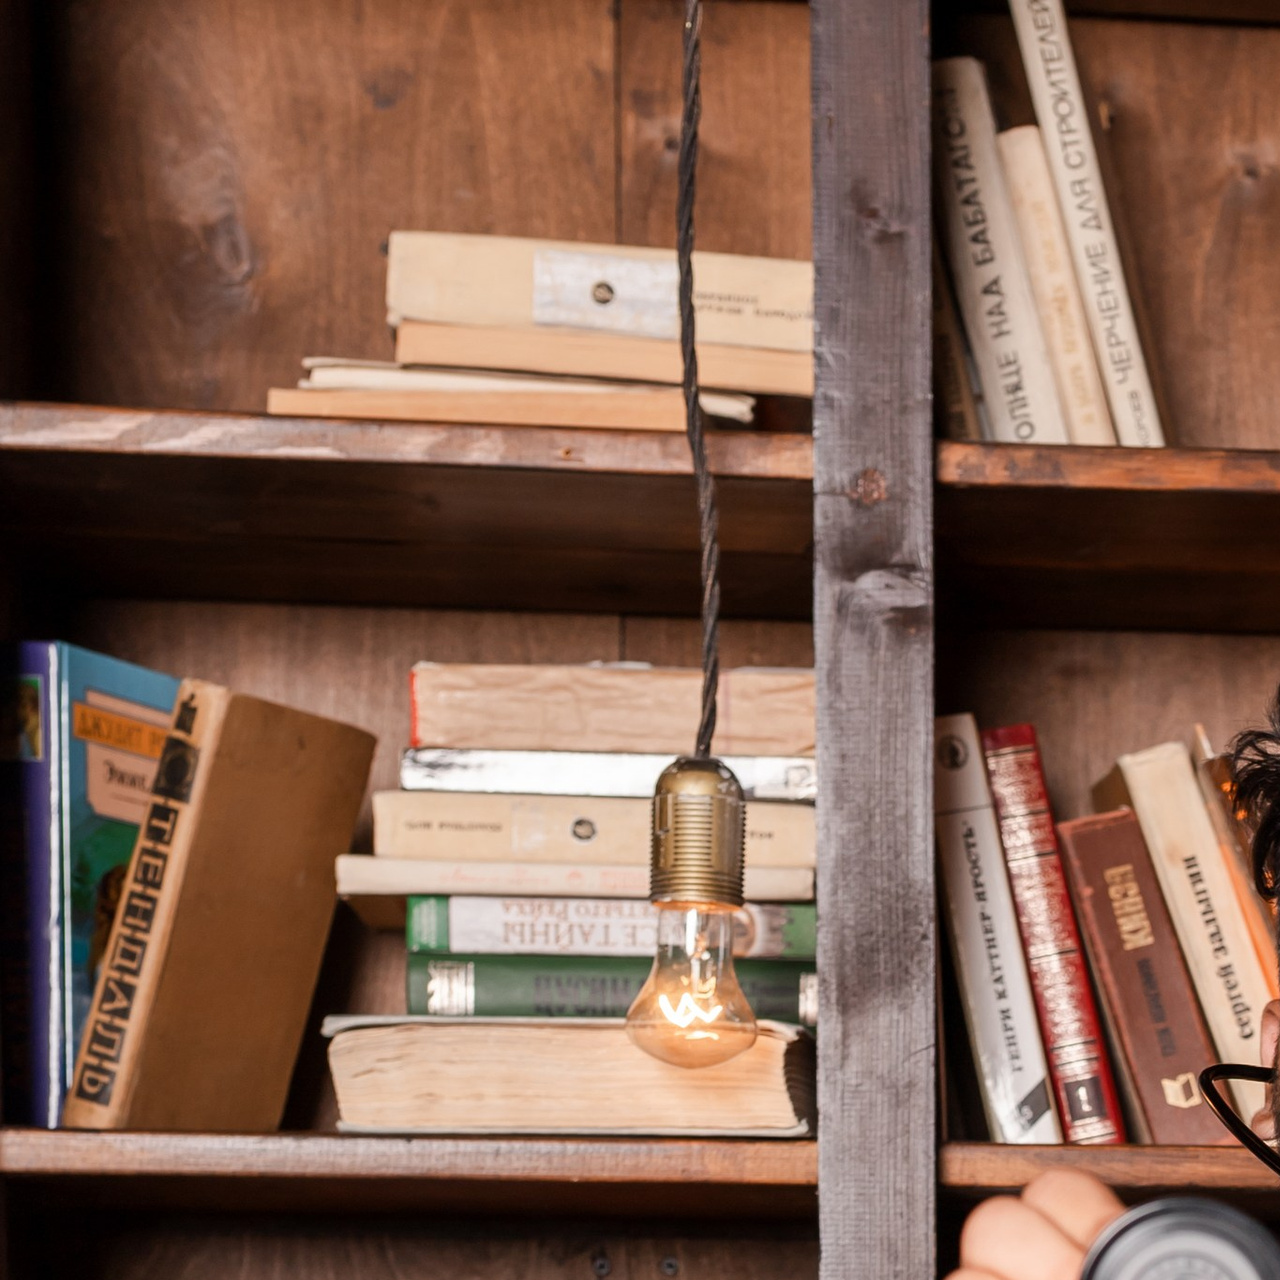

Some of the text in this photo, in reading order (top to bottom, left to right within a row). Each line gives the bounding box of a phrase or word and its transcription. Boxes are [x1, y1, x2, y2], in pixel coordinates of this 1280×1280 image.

[1022, 0, 1092, 172] СТРОИТЕЛЕЙ
[1067, 176, 1103, 235] ДЛЯ
[978, 274, 1015, 339] НАД
[1081, 240, 1139, 385] ЧЕРЧЕНИЕ
[994, 350, 1037, 442] ОЛНЦЕ
[502, 919, 658, 952] СЕ ТАЙНЫ
[977, 909, 1007, 1001] КАТТНЕР
[997, 1006, 1023, 1073] ГЕНРИ
